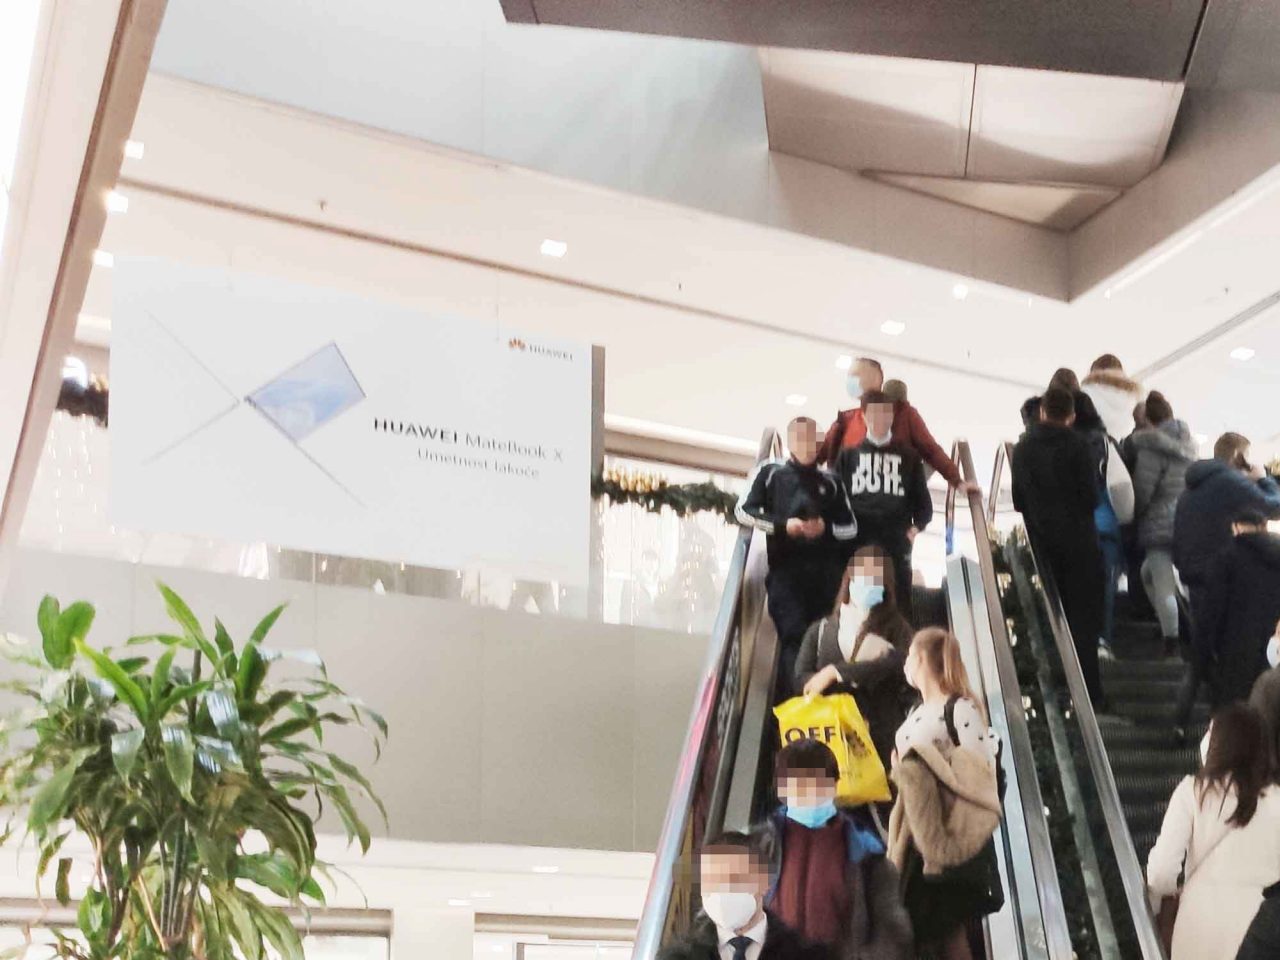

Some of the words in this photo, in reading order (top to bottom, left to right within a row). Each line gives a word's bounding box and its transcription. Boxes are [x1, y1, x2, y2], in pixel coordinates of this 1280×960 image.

[528, 343, 574, 361] HUAWEI
[374, 417, 458, 443] HUAWEI
[465, 432, 546, 460] MateBook
[552, 449, 564, 462] X
[417, 447, 487, 470] Umetnost
[851, 472, 881, 495] DO
